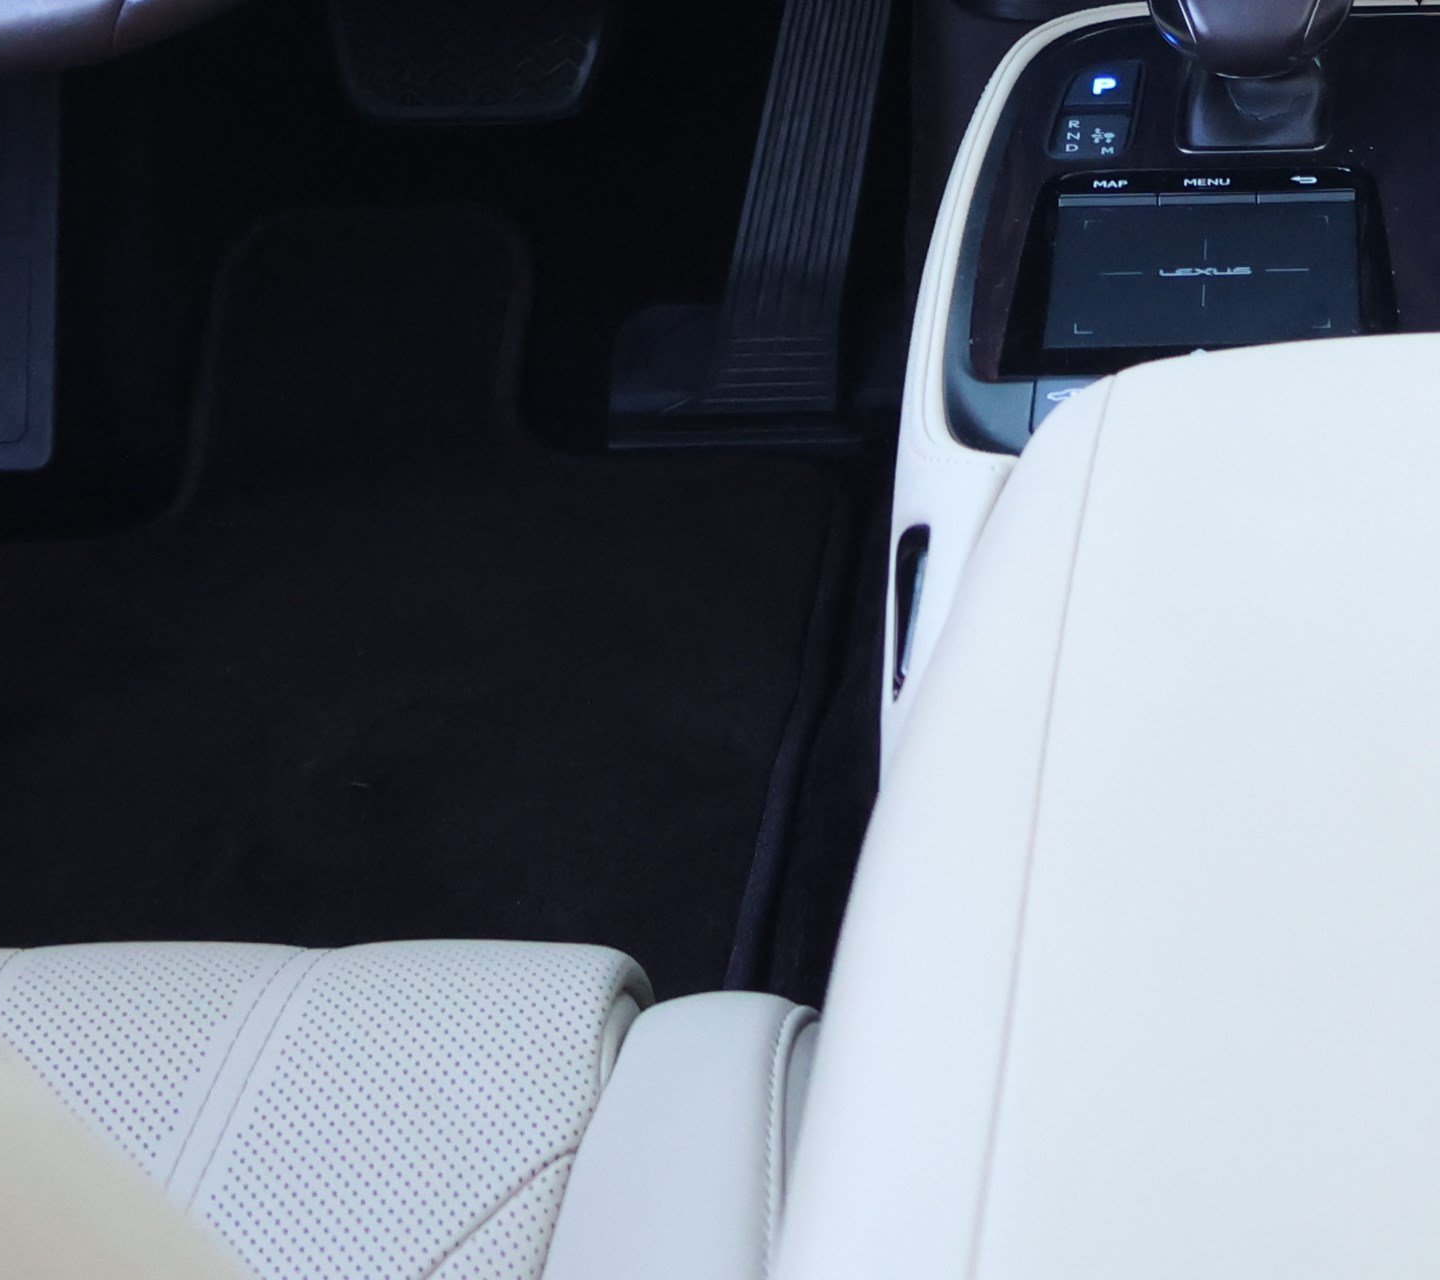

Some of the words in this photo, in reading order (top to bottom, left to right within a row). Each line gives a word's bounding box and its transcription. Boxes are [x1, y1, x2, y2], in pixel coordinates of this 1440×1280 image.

[1093, 77, 1117, 95] P
[1068, 119, 1081, 128] R
[1067, 131, 1081, 140] N
[1066, 143, 1079, 152] D
[1100, 146, 1114, 154] M
[1093, 179, 1128, 189] MAP
[1183, 177, 1230, 187] MENU
[1159, 266, 1253, 277] LEXUS
